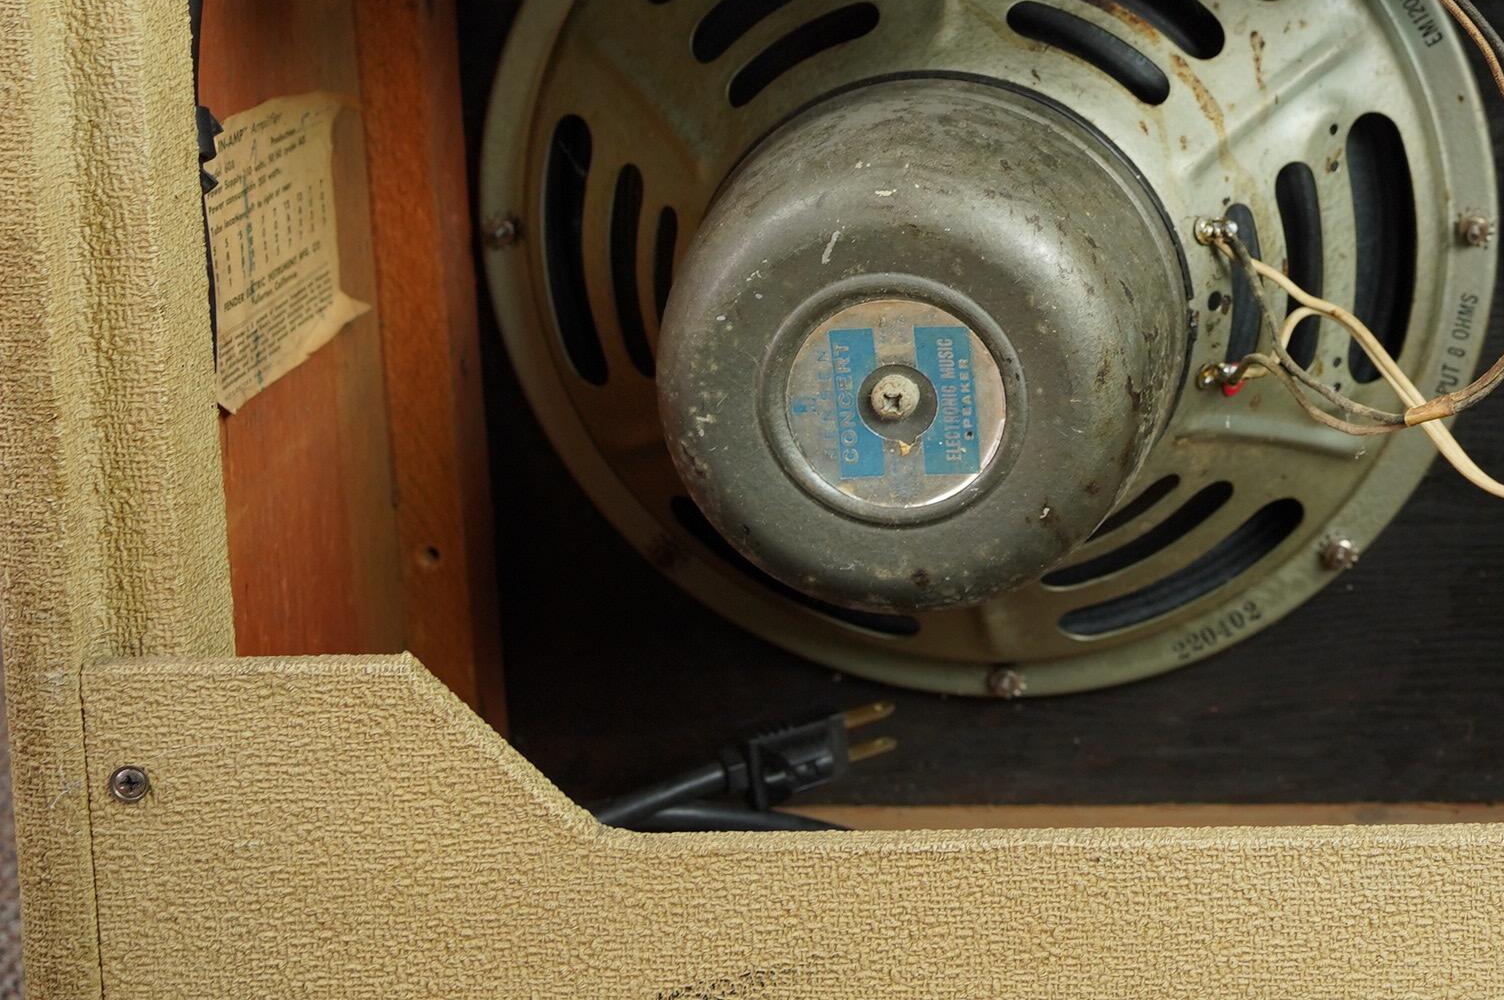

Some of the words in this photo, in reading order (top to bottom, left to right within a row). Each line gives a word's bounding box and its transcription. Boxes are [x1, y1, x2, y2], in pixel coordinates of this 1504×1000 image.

[1453, 292, 1479, 341] OHMS
[936, 337, 956, 380] MUSIC
[834, 344, 859, 465] CONCERT
[940, 385, 963, 462] ELECTRONIC
